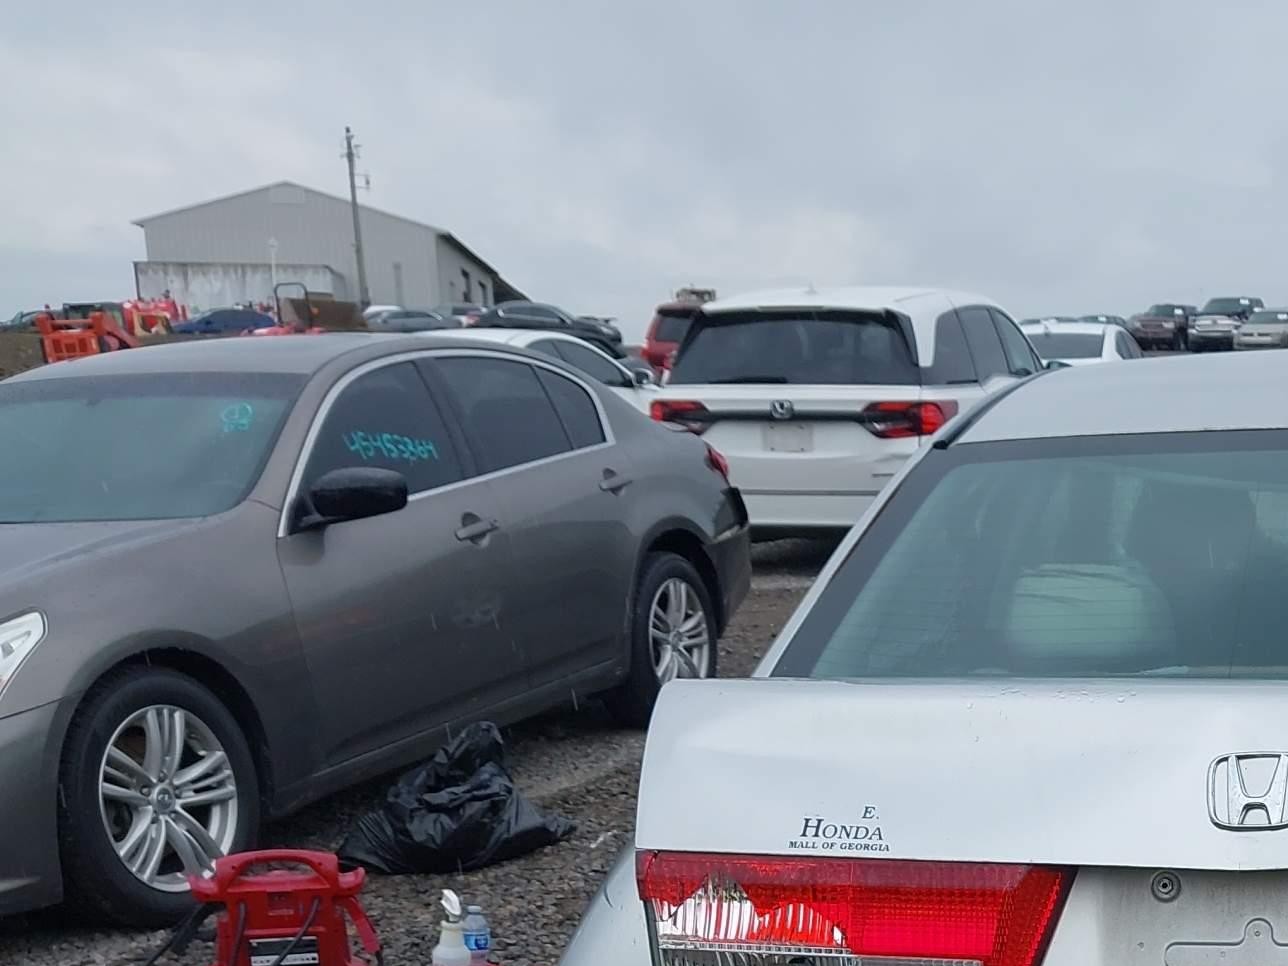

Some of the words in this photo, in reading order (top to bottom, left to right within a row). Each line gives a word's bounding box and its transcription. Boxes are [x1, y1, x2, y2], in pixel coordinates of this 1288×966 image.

[799, 817, 884, 841] HONDA
[788, 840, 819, 850] MALL
[821, 841, 838, 851] OF
[839, 842, 890, 853] GEORGIA
